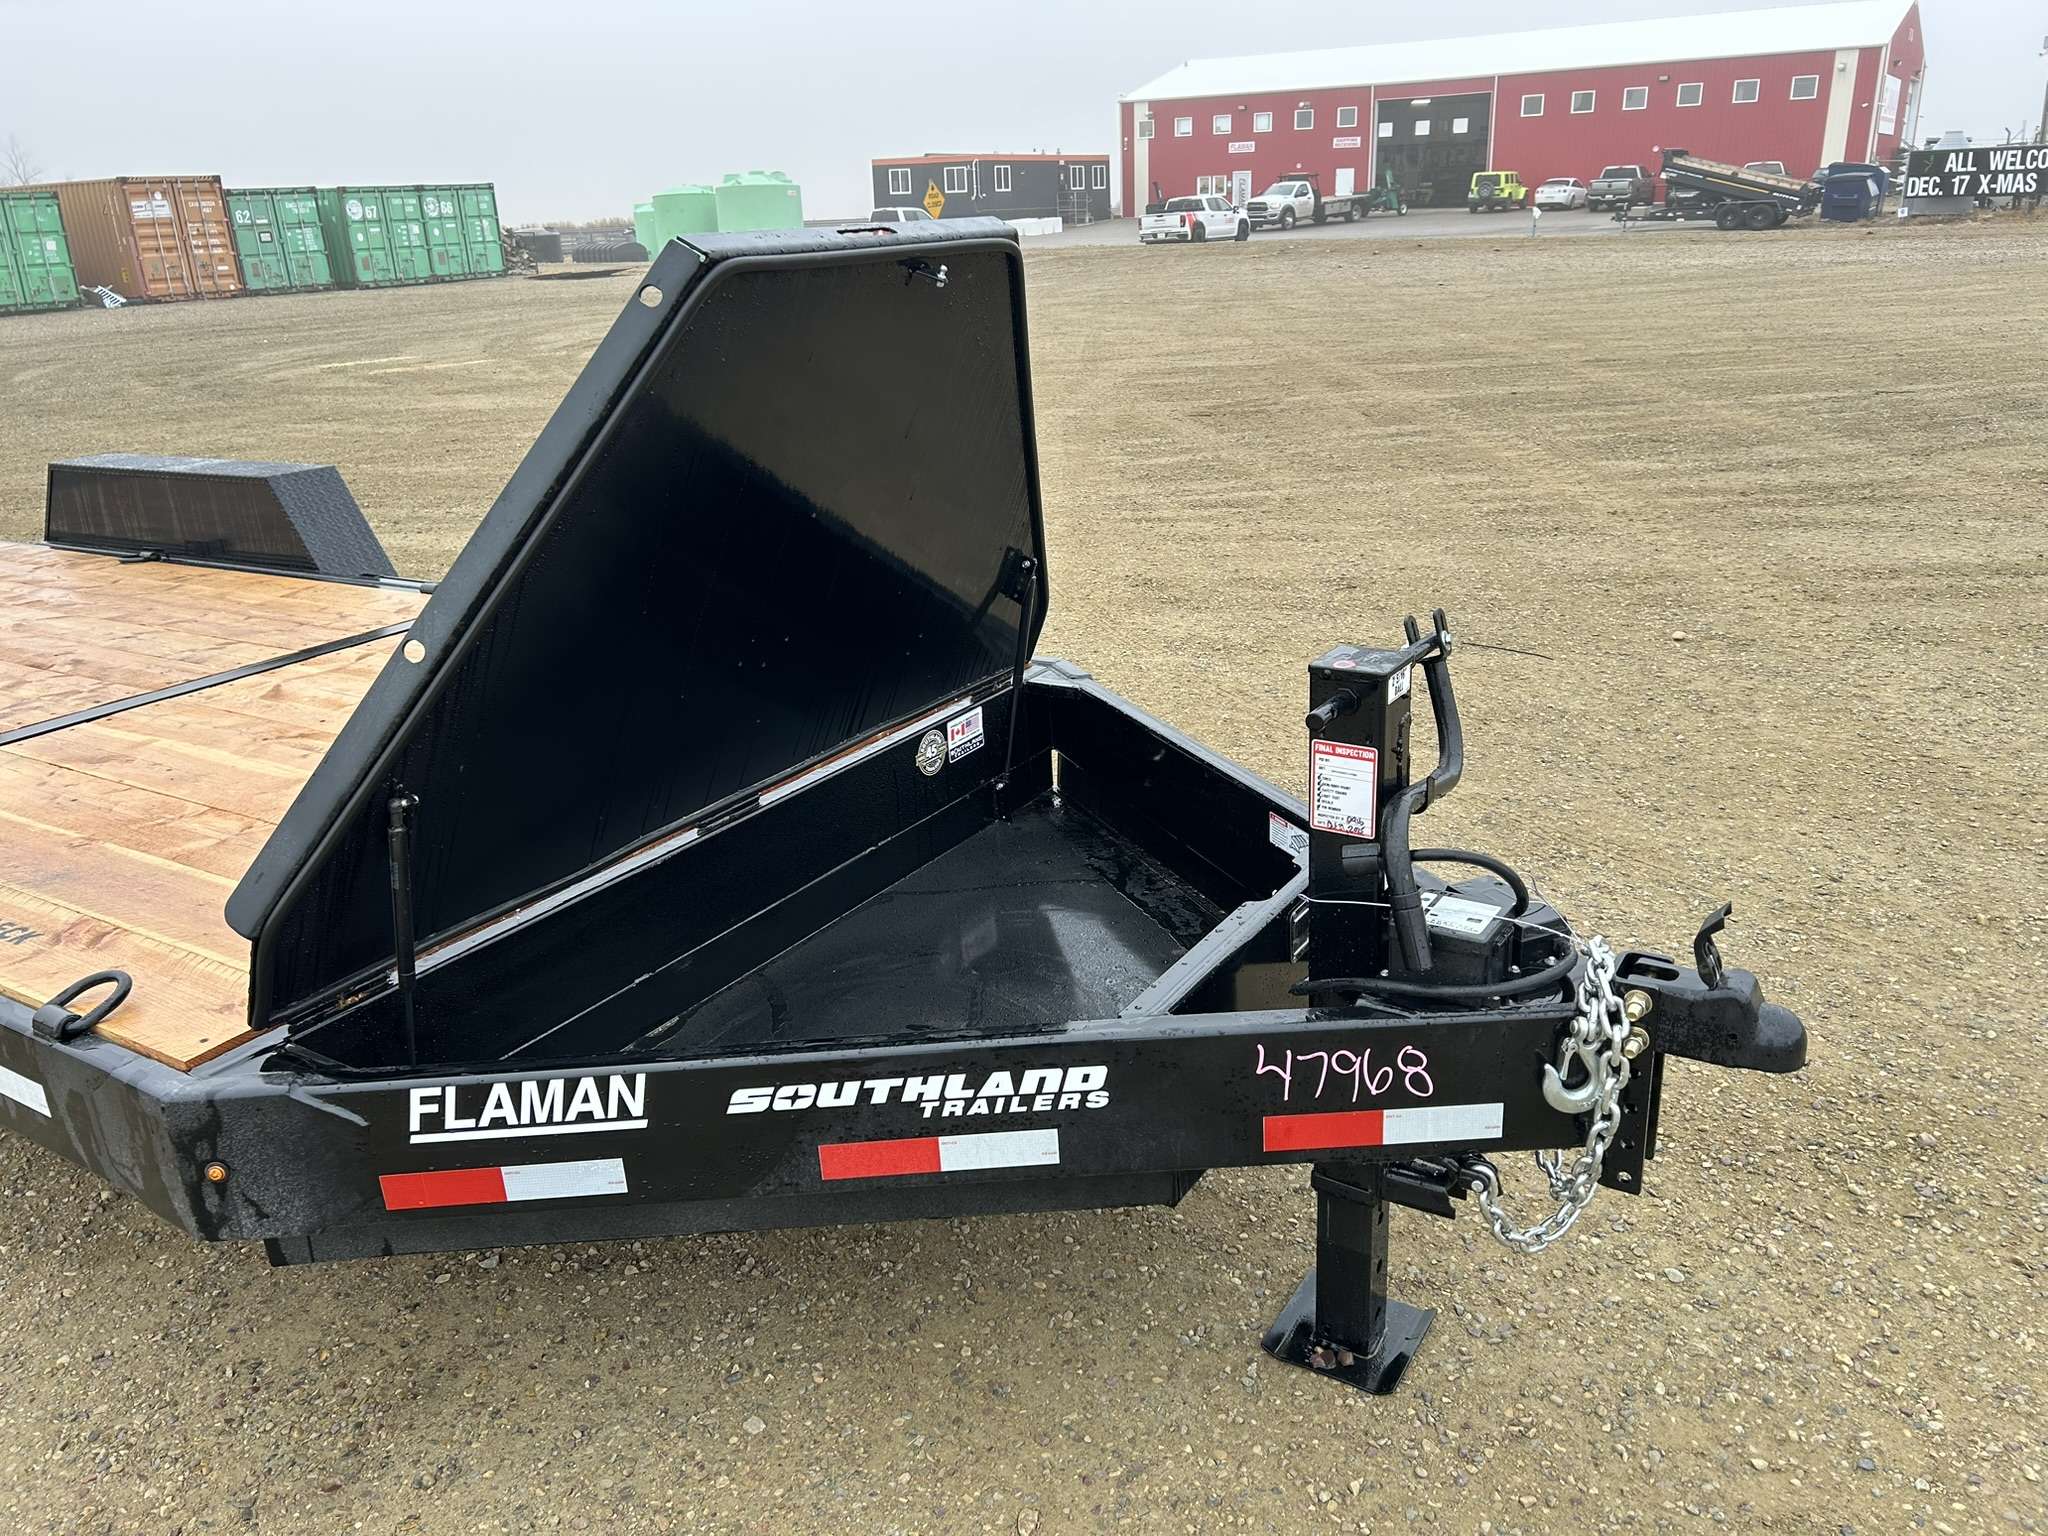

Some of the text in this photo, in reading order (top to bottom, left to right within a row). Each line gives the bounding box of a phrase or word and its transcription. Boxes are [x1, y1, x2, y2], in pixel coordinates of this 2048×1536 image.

[1944, 148, 2048, 173] ALL WELCO
[1906, 172, 2038, 197] DEC. 17 X-MAS
[235, 210, 251, 223] 62
[365, 205, 377, 218] 67
[440, 201, 453, 214] 66
[1315, 743, 1375, 759] FINAL INSPECTION
[1256, 1044, 1434, 1103] 47968
[726, 1065, 1109, 1114] SOUTHLAND
[410, 1073, 646, 1132] FLAMAN
[920, 1090, 1110, 1119] TRAILERS
